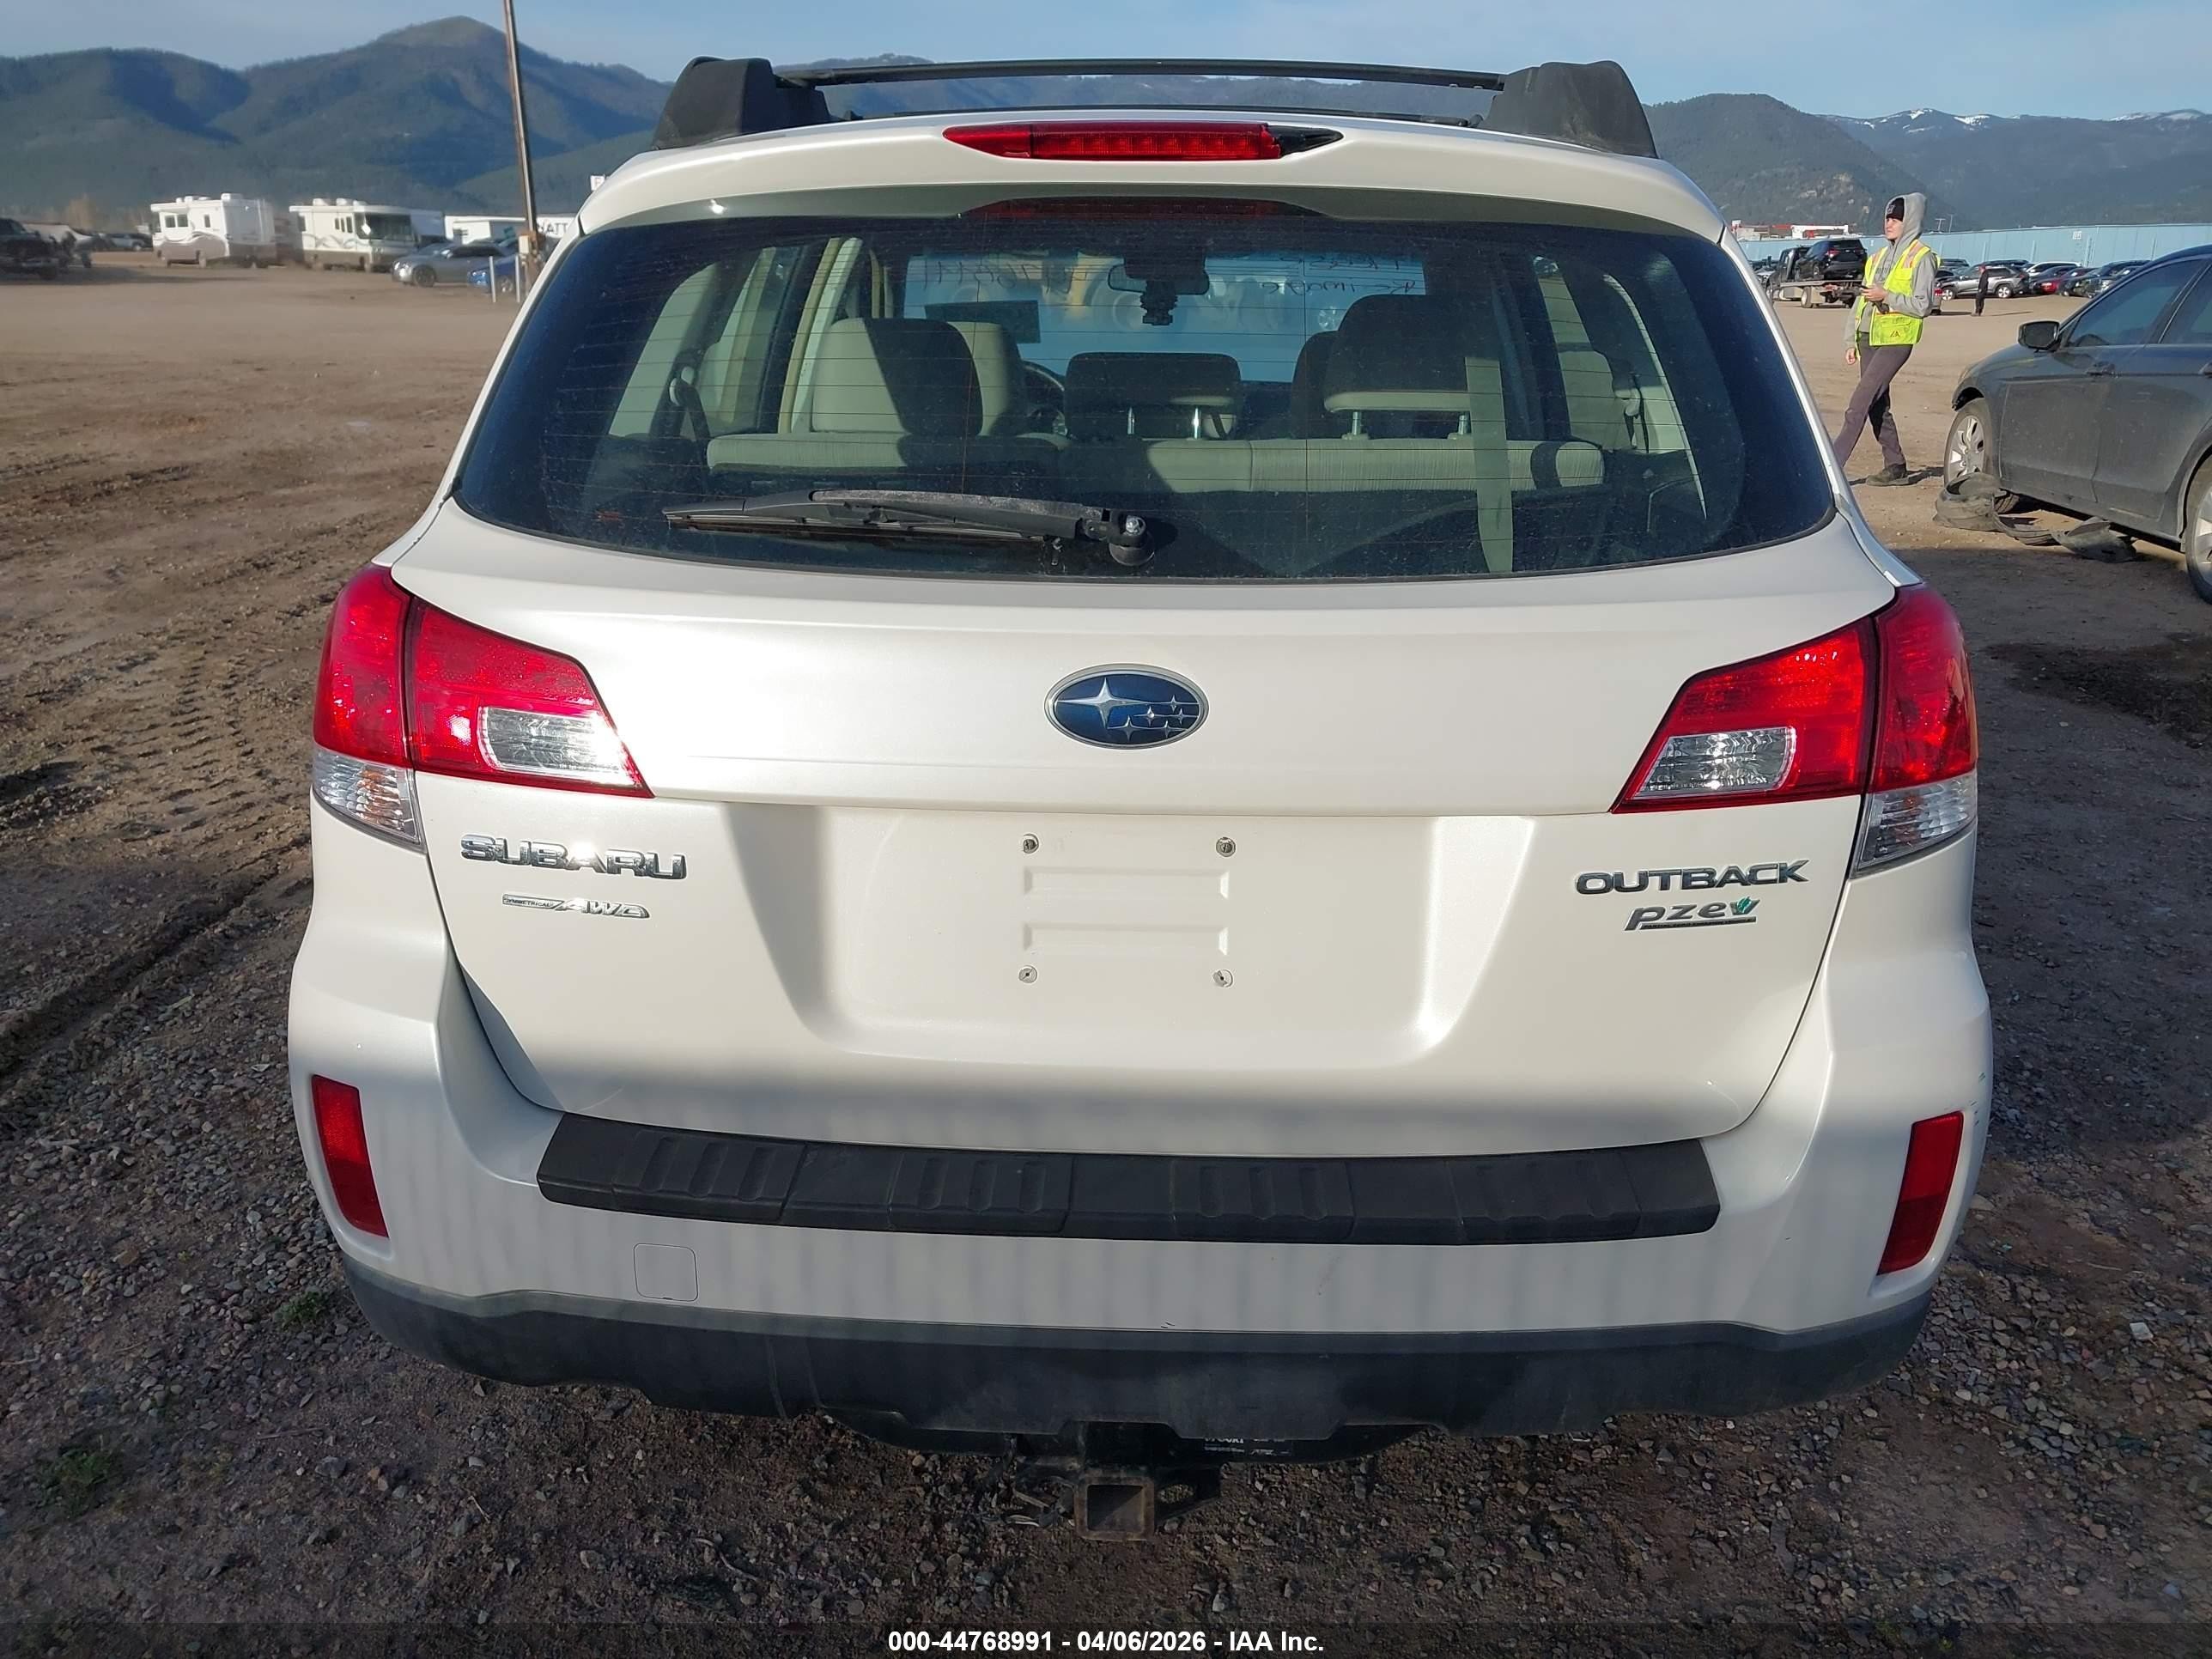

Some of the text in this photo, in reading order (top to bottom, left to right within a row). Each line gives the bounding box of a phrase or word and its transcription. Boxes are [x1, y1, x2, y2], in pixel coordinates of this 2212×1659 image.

[460, 834, 687, 879] SUBARU
[1576, 860, 1809, 895] OUTBACK
[554, 898, 650, 919] AWD
